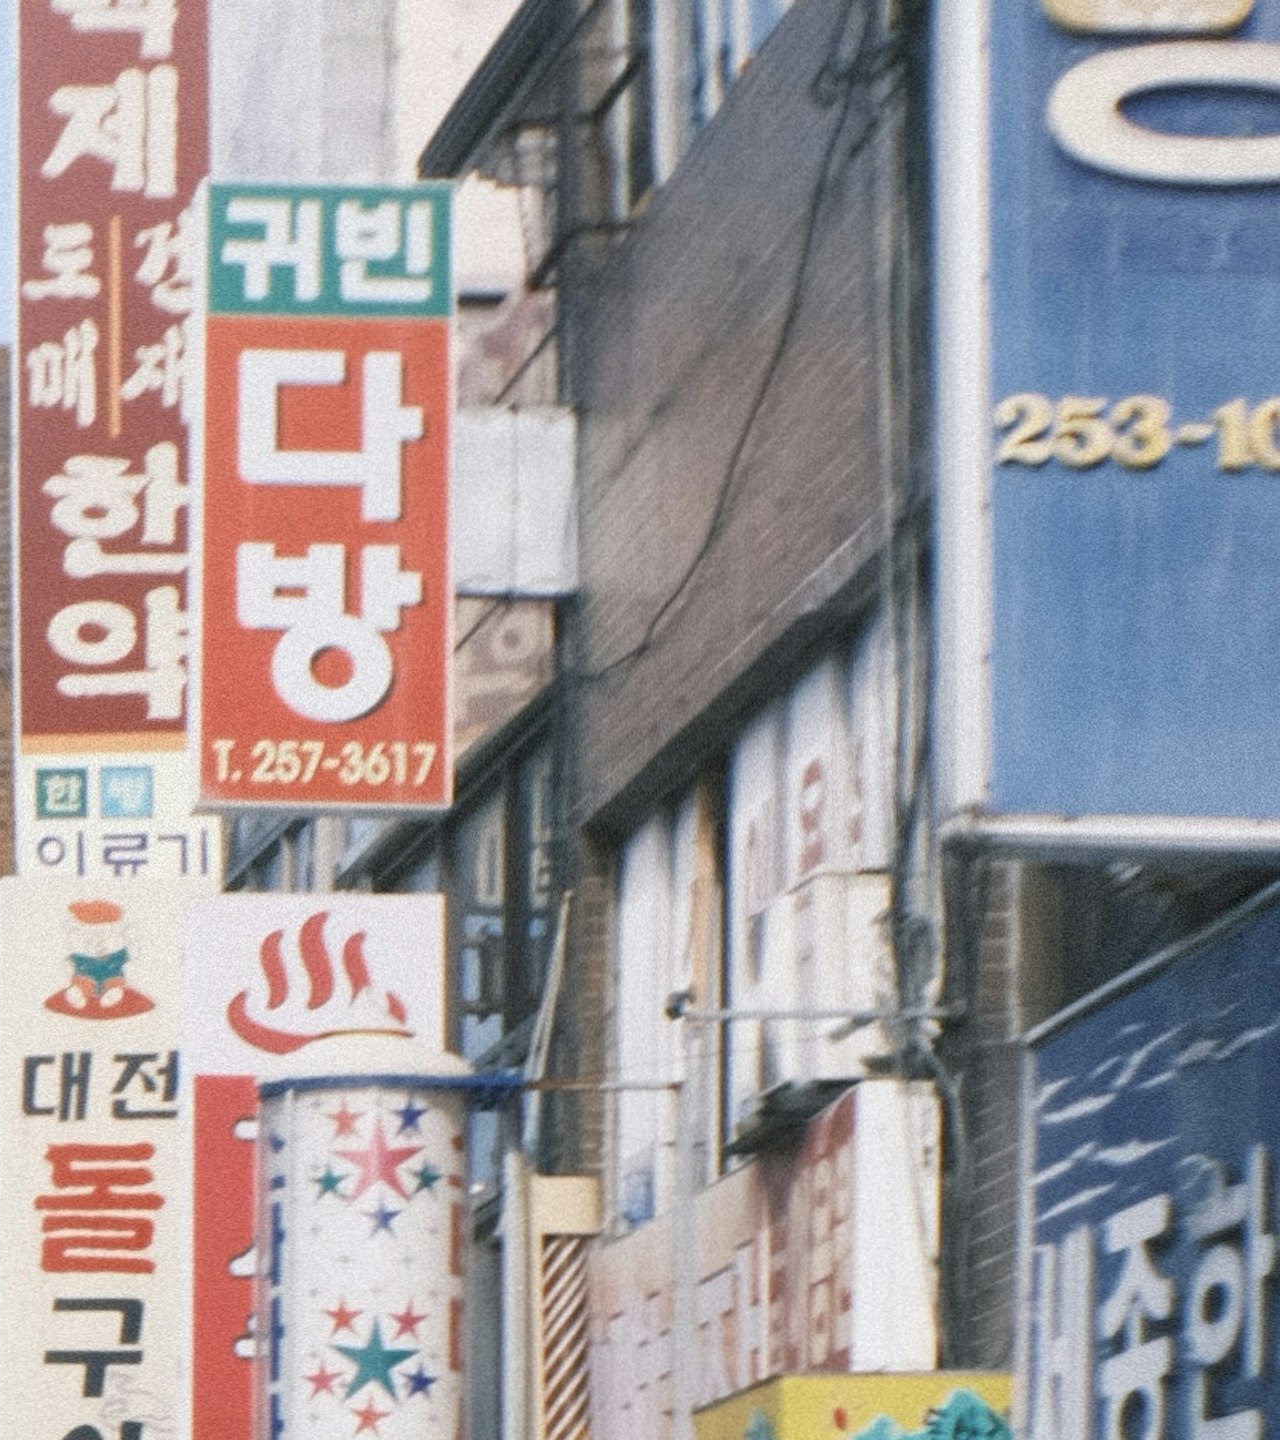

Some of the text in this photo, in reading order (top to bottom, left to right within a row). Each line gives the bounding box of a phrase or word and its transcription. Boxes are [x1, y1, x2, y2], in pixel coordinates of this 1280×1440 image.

[221, 194, 436, 307] 귀빈
[21, 220, 103, 428] 도매
[237, 347, 426, 726] 다방
[249, 737, 437, 791] 257-3617
[21, 1047, 180, 1123] 대전
